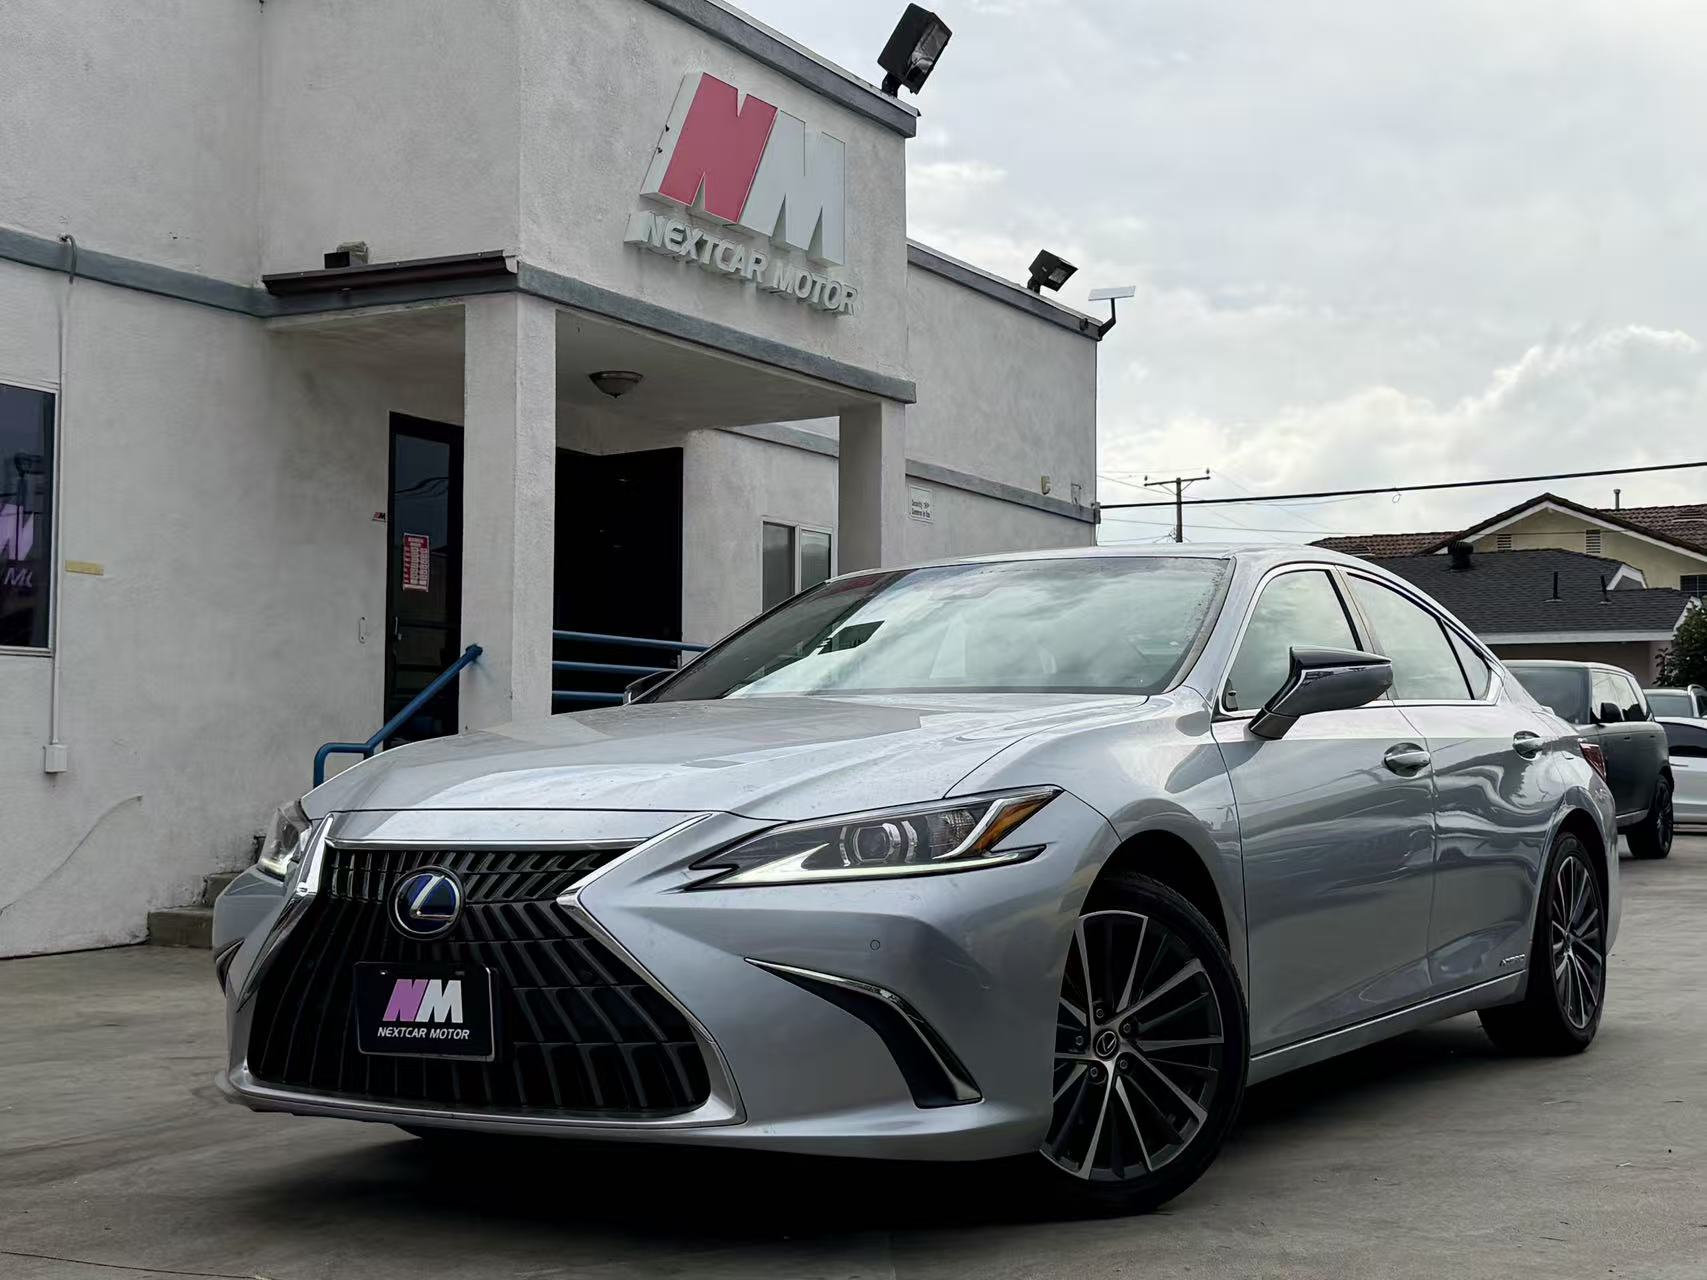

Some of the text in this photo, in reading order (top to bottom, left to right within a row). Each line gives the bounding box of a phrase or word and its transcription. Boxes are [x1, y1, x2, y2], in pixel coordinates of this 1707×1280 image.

[630, 210, 859, 316] NEXTCAR MOTOR
[377, 1026, 470, 1040] NEXTCAR MOTOR
